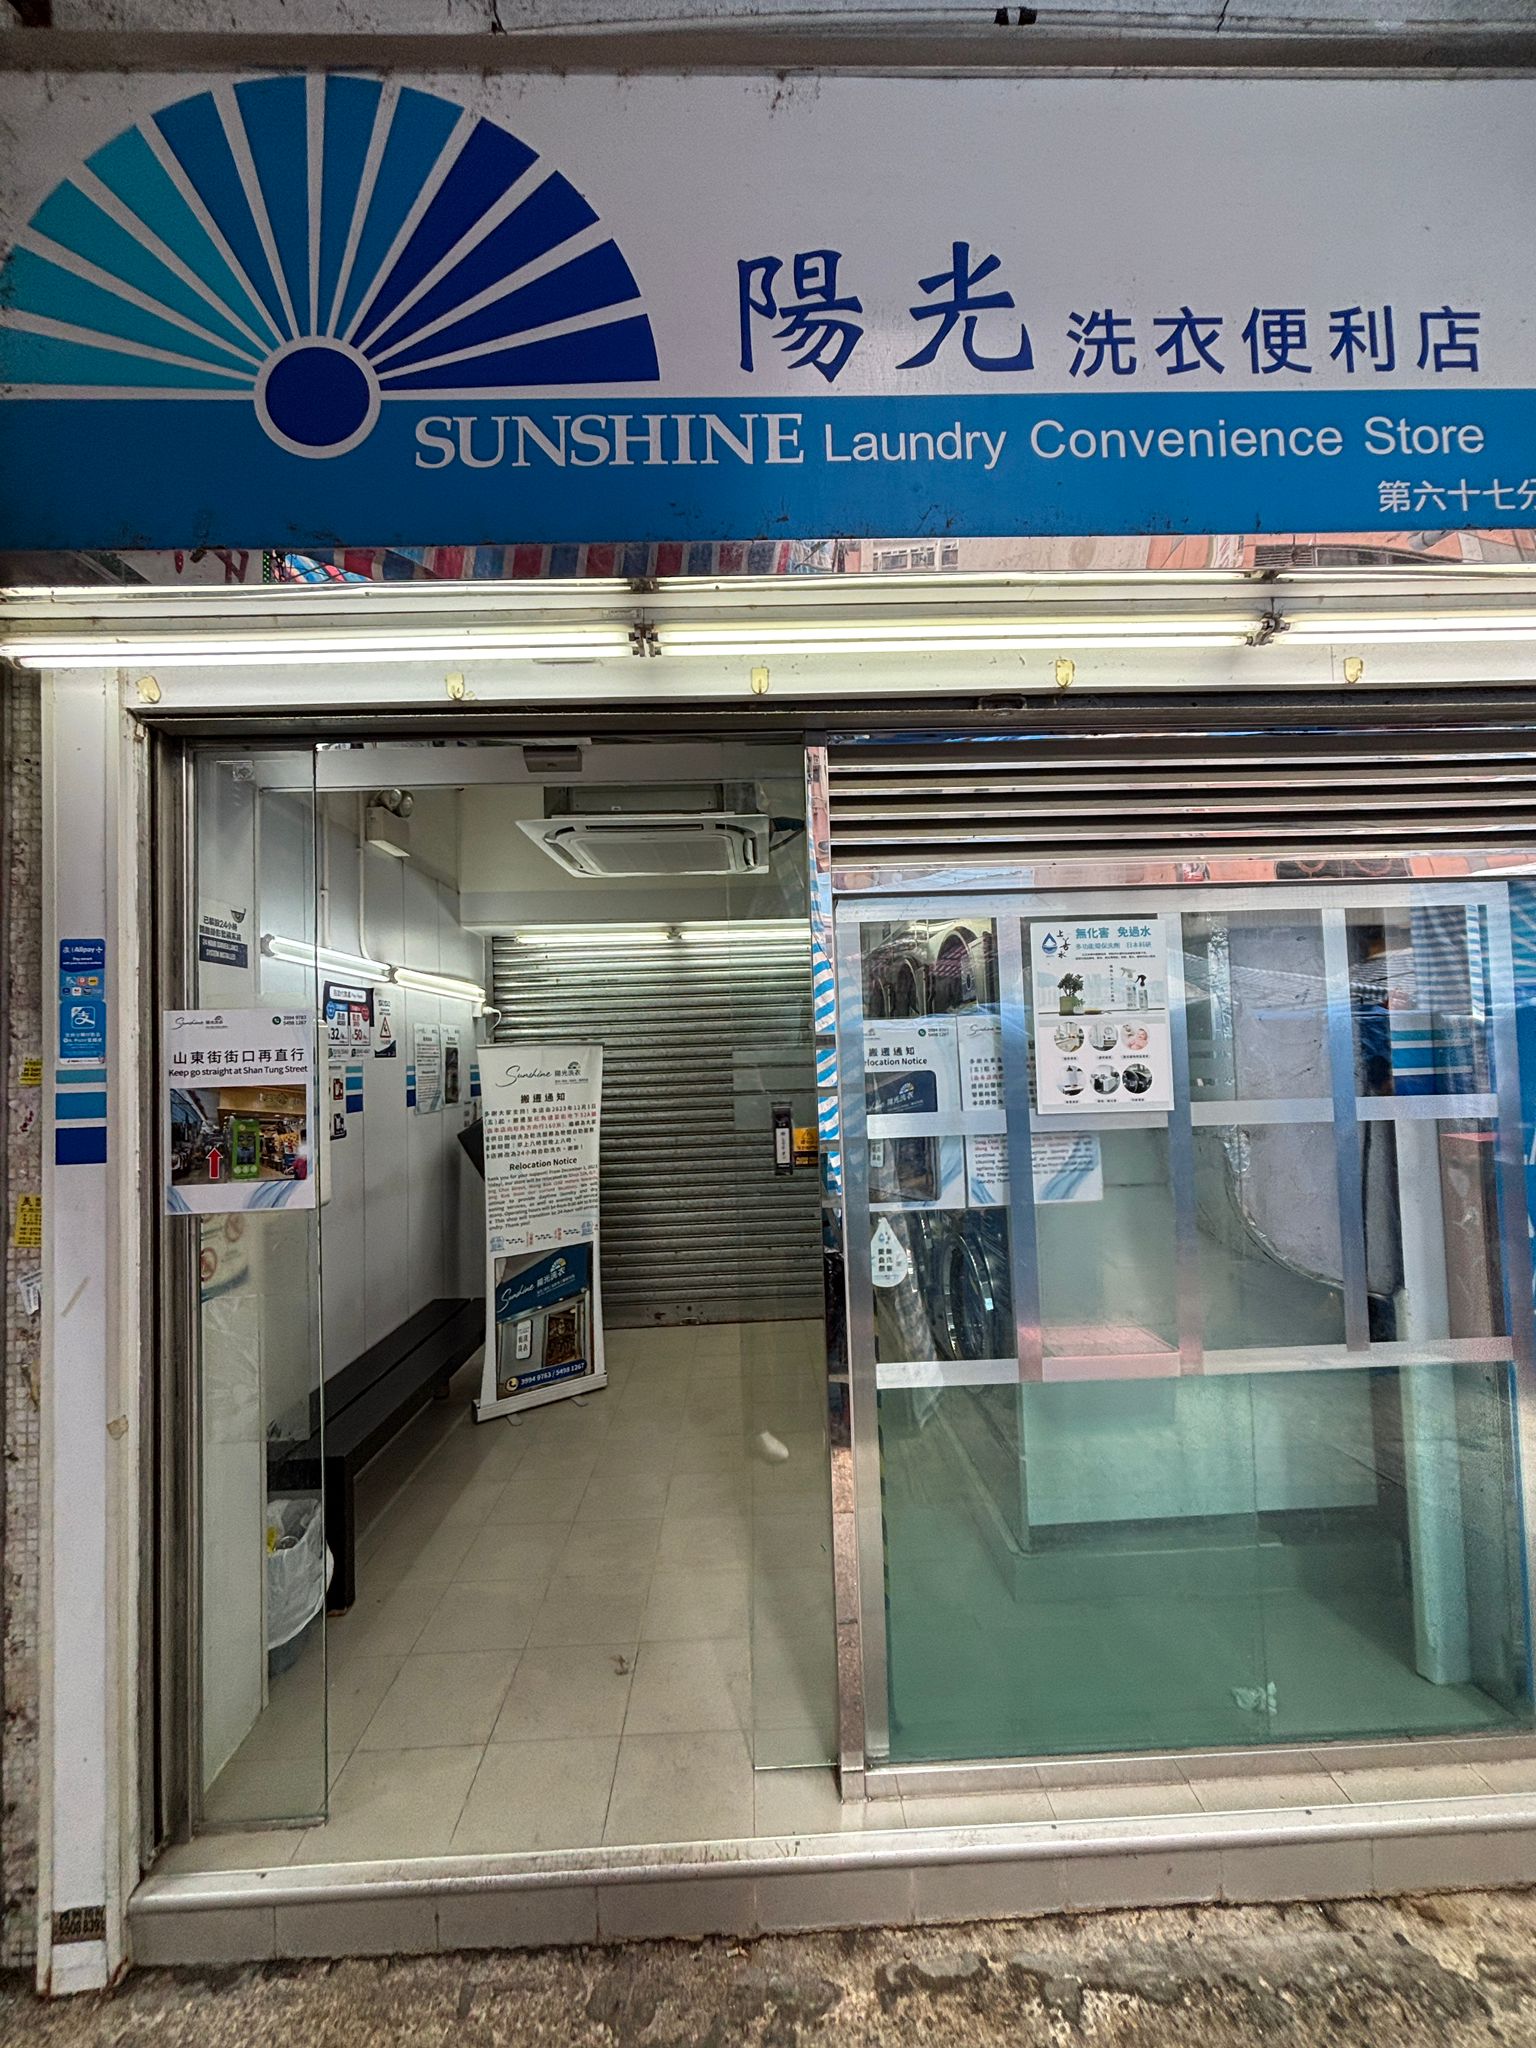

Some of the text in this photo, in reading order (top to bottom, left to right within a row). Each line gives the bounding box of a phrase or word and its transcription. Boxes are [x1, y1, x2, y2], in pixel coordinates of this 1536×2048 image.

[736, 240, 1481, 384] 陽光 洗衣便利店
[414, 412, 1485, 471] SUNSHINE Laundry Convenience Store
[1075, 925, 1151, 940] 無化害 免過水
[173, 1047, 305, 1065] 山東街街口再直行
[865, 1057, 928, 1067] location Notice
[168, 1068, 189, 1077] Keep
[190, 1069, 201, 1078] go
[202, 1067, 233, 1077] straight
[243, 1065, 263, 1074] Shan
[264, 1066, 284, 1075] Tung
[285, 1064, 308, 1073] Street
[495, 1065, 552, 1088] Sunshine
[521, 1092, 566, 1104] 搬遷通知
[509, 1156, 578, 1171] Relocation Notice
[496, 1283, 535, 1313] Sunshine
[520, 1375, 536, 1386] 3994
[556, 1367, 571, 1377] 5498
[571, 1362, 585, 1372] 1267
